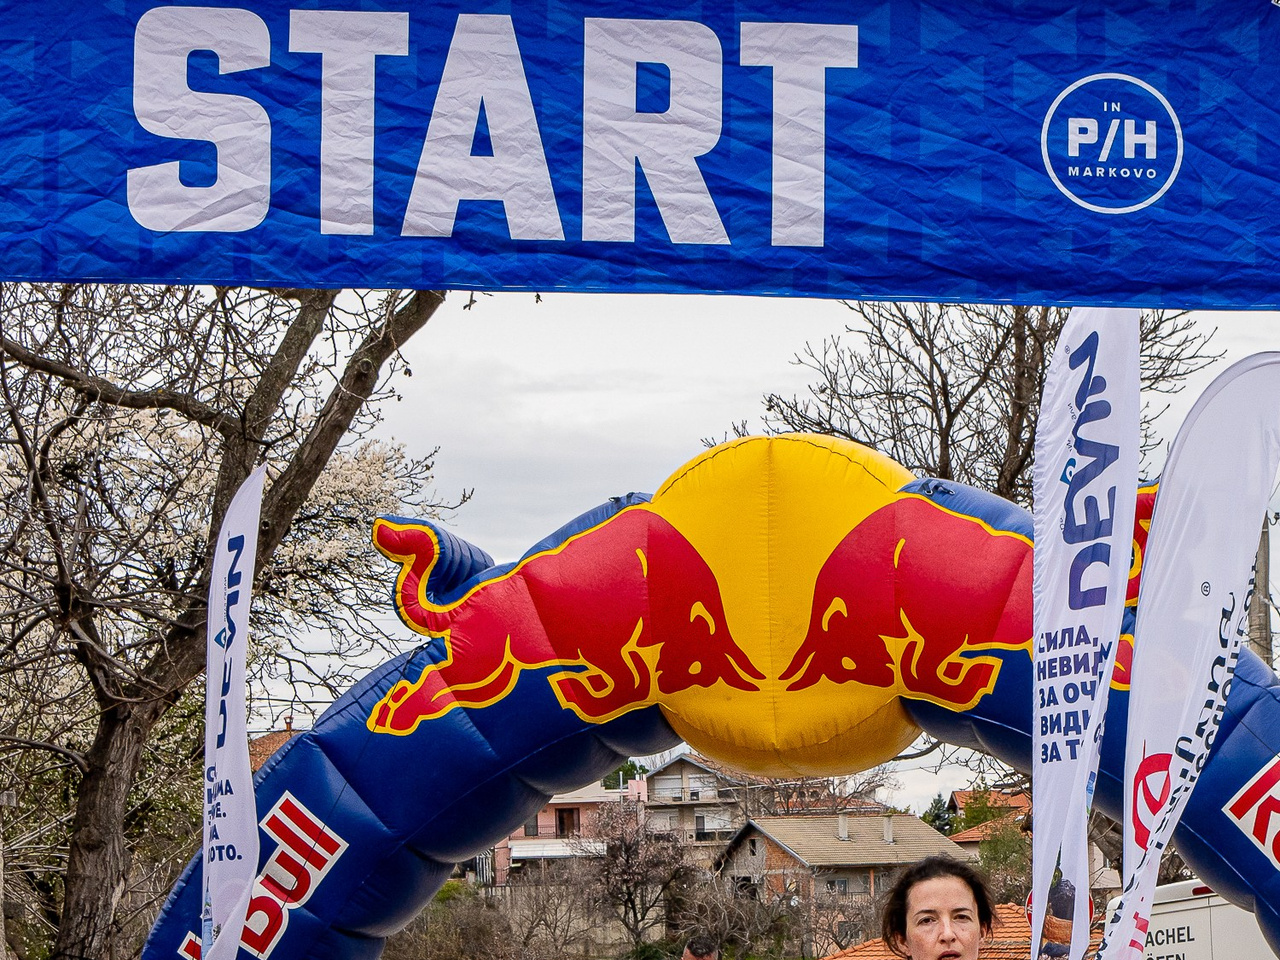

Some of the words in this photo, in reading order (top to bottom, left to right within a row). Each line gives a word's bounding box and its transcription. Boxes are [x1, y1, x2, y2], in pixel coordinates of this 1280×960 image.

[1103, 101, 1121, 112] IN
[126, 6, 860, 247] START
[1067, 117, 1157, 162] P/H
[1067, 166, 1157, 179] MARKOVO
[1145, 926, 1195, 947] ACHEL
